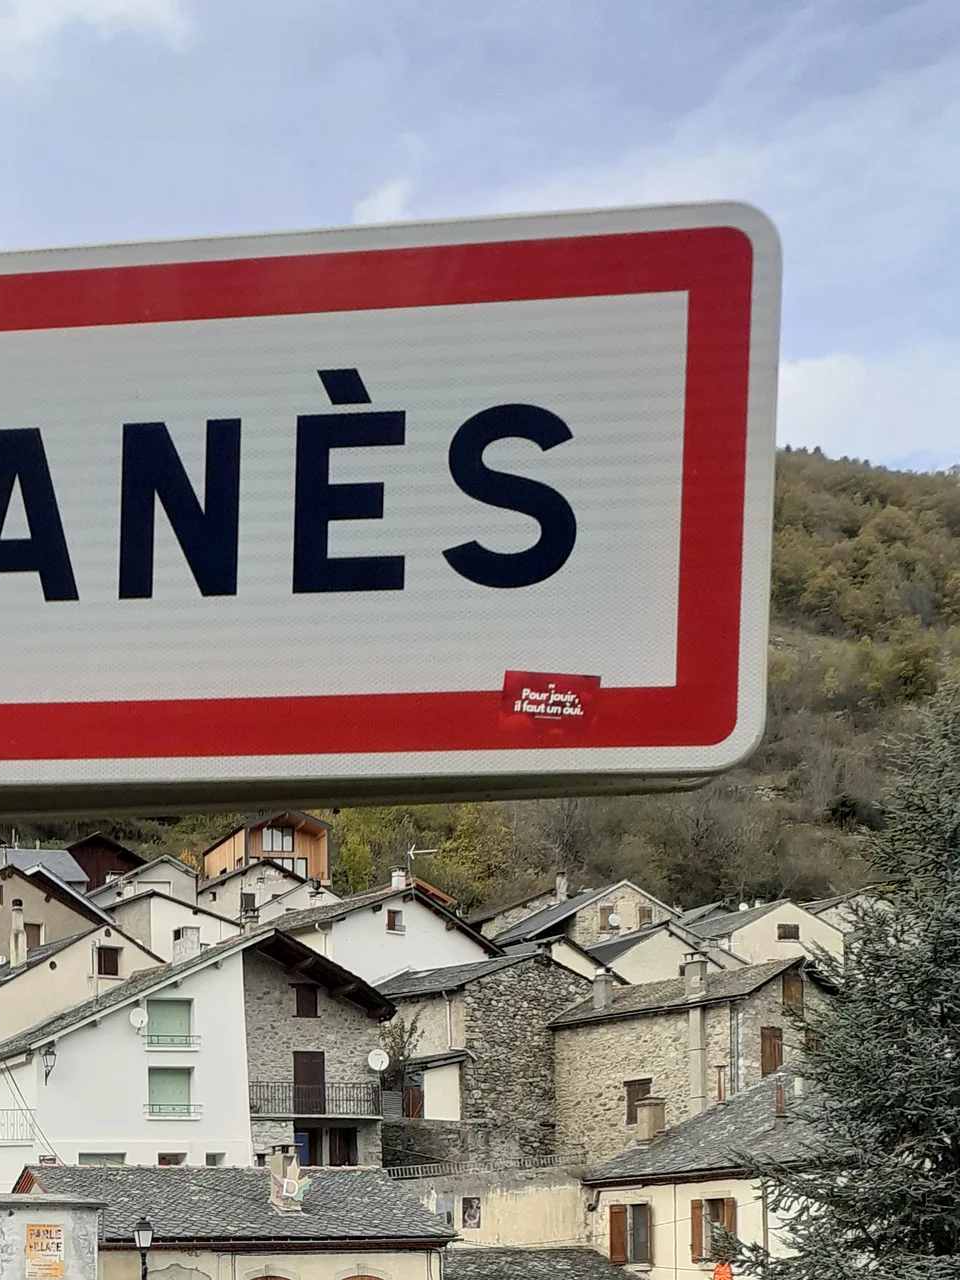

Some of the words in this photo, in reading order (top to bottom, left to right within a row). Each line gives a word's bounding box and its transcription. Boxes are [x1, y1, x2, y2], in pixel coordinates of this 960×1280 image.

[521, 688, 549, 700] Pour
[549, 690, 579, 704] jouir,
[514, 700, 521, 712] il
[522, 700, 546, 713] faut
[546, 705, 561, 714] un
[562, 704, 584, 715] oui.
[283, 1179, 298, 1197] D
